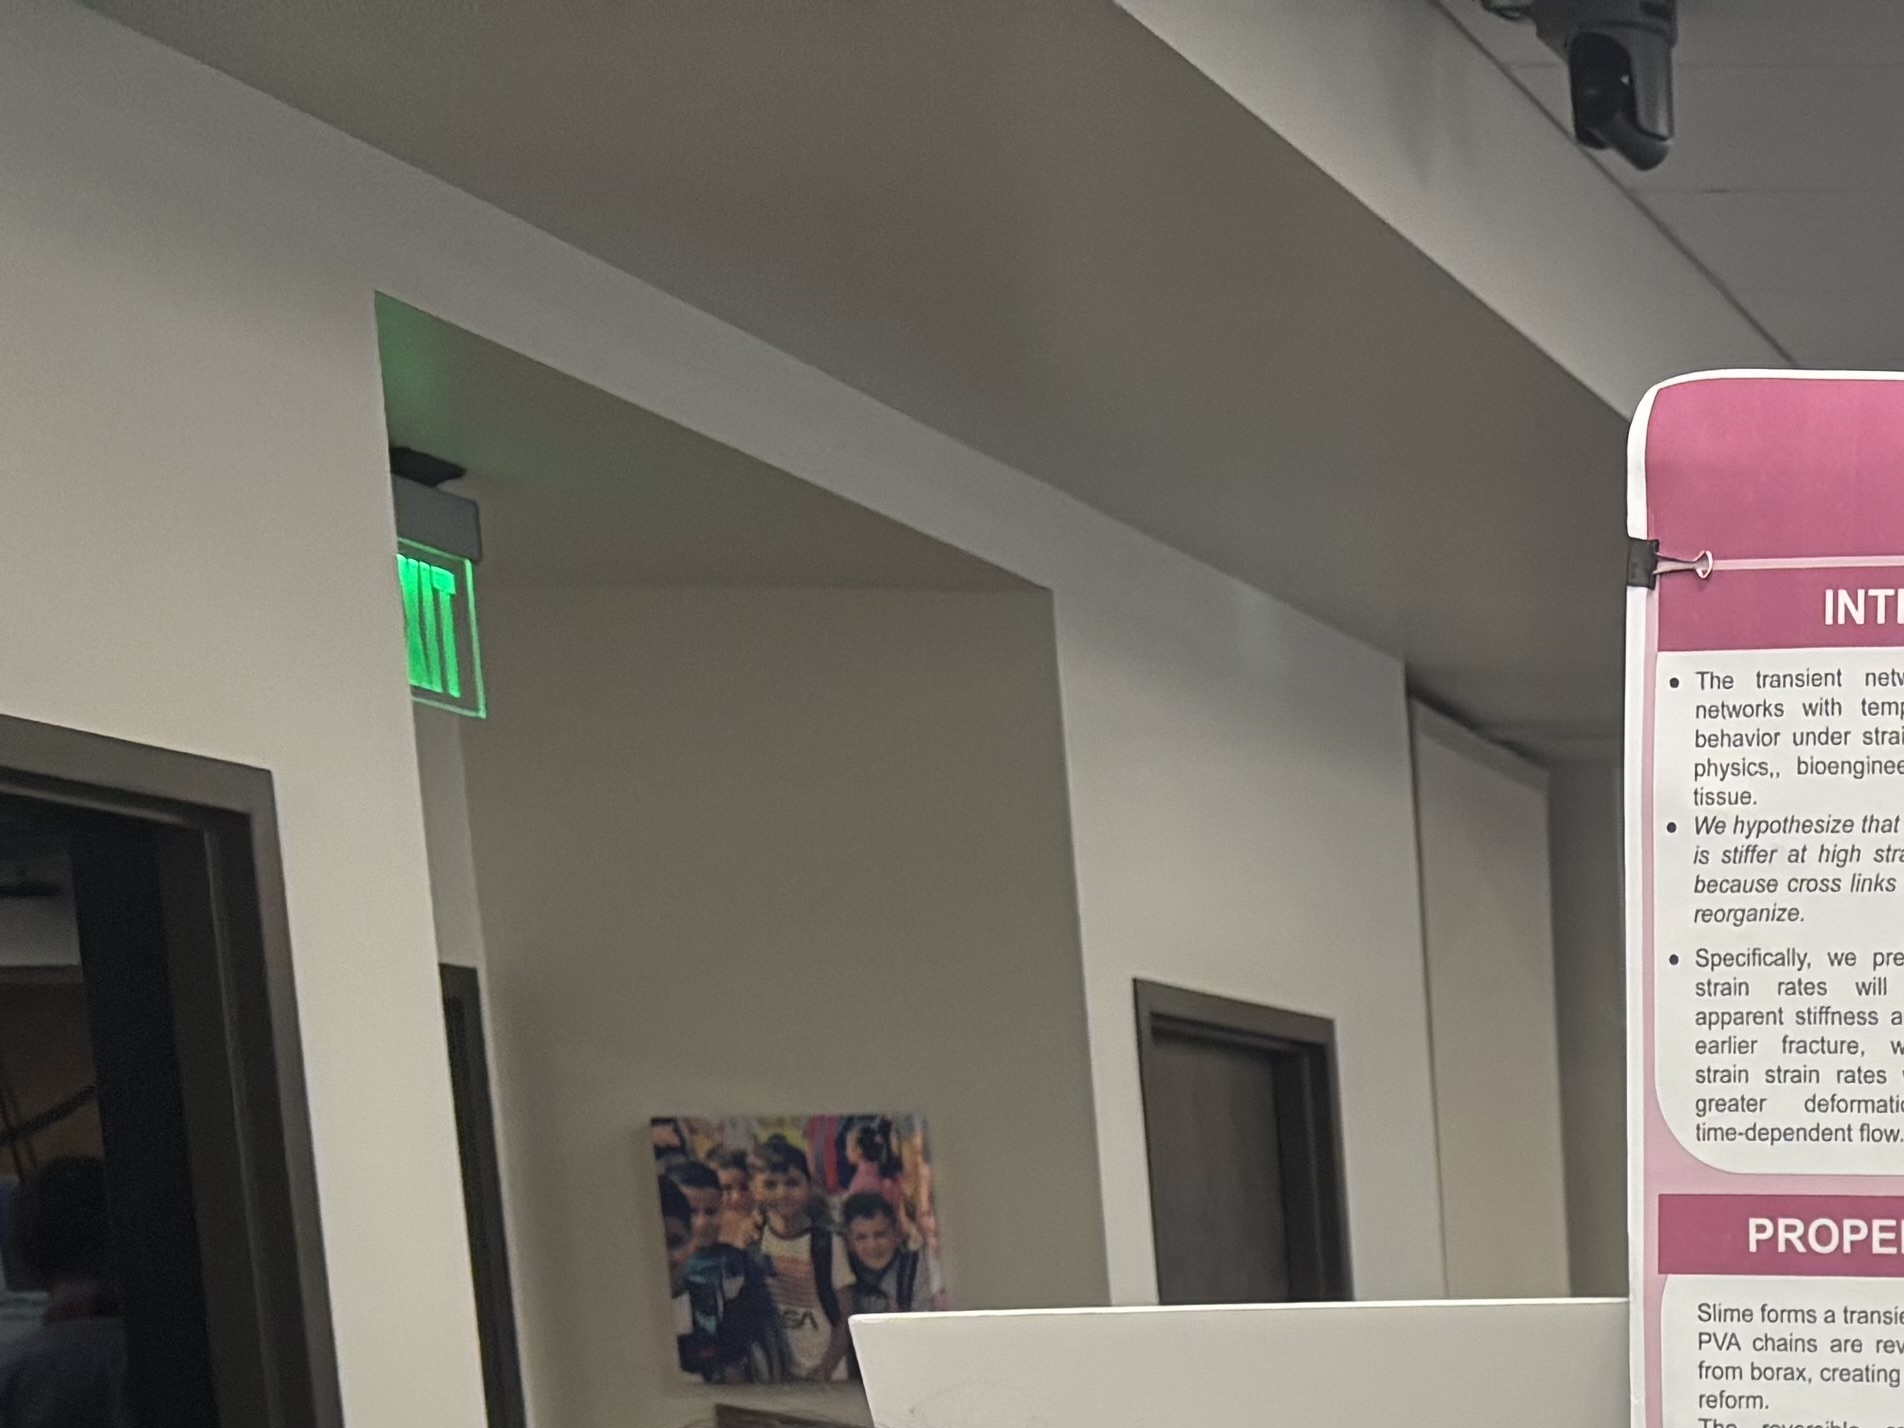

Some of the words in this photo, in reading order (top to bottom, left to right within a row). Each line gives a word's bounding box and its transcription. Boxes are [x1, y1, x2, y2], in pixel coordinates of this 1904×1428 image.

[396, 554, 461, 698] XIT
[1696, 672, 1734, 690] The
[1756, 668, 1842, 688] transient
